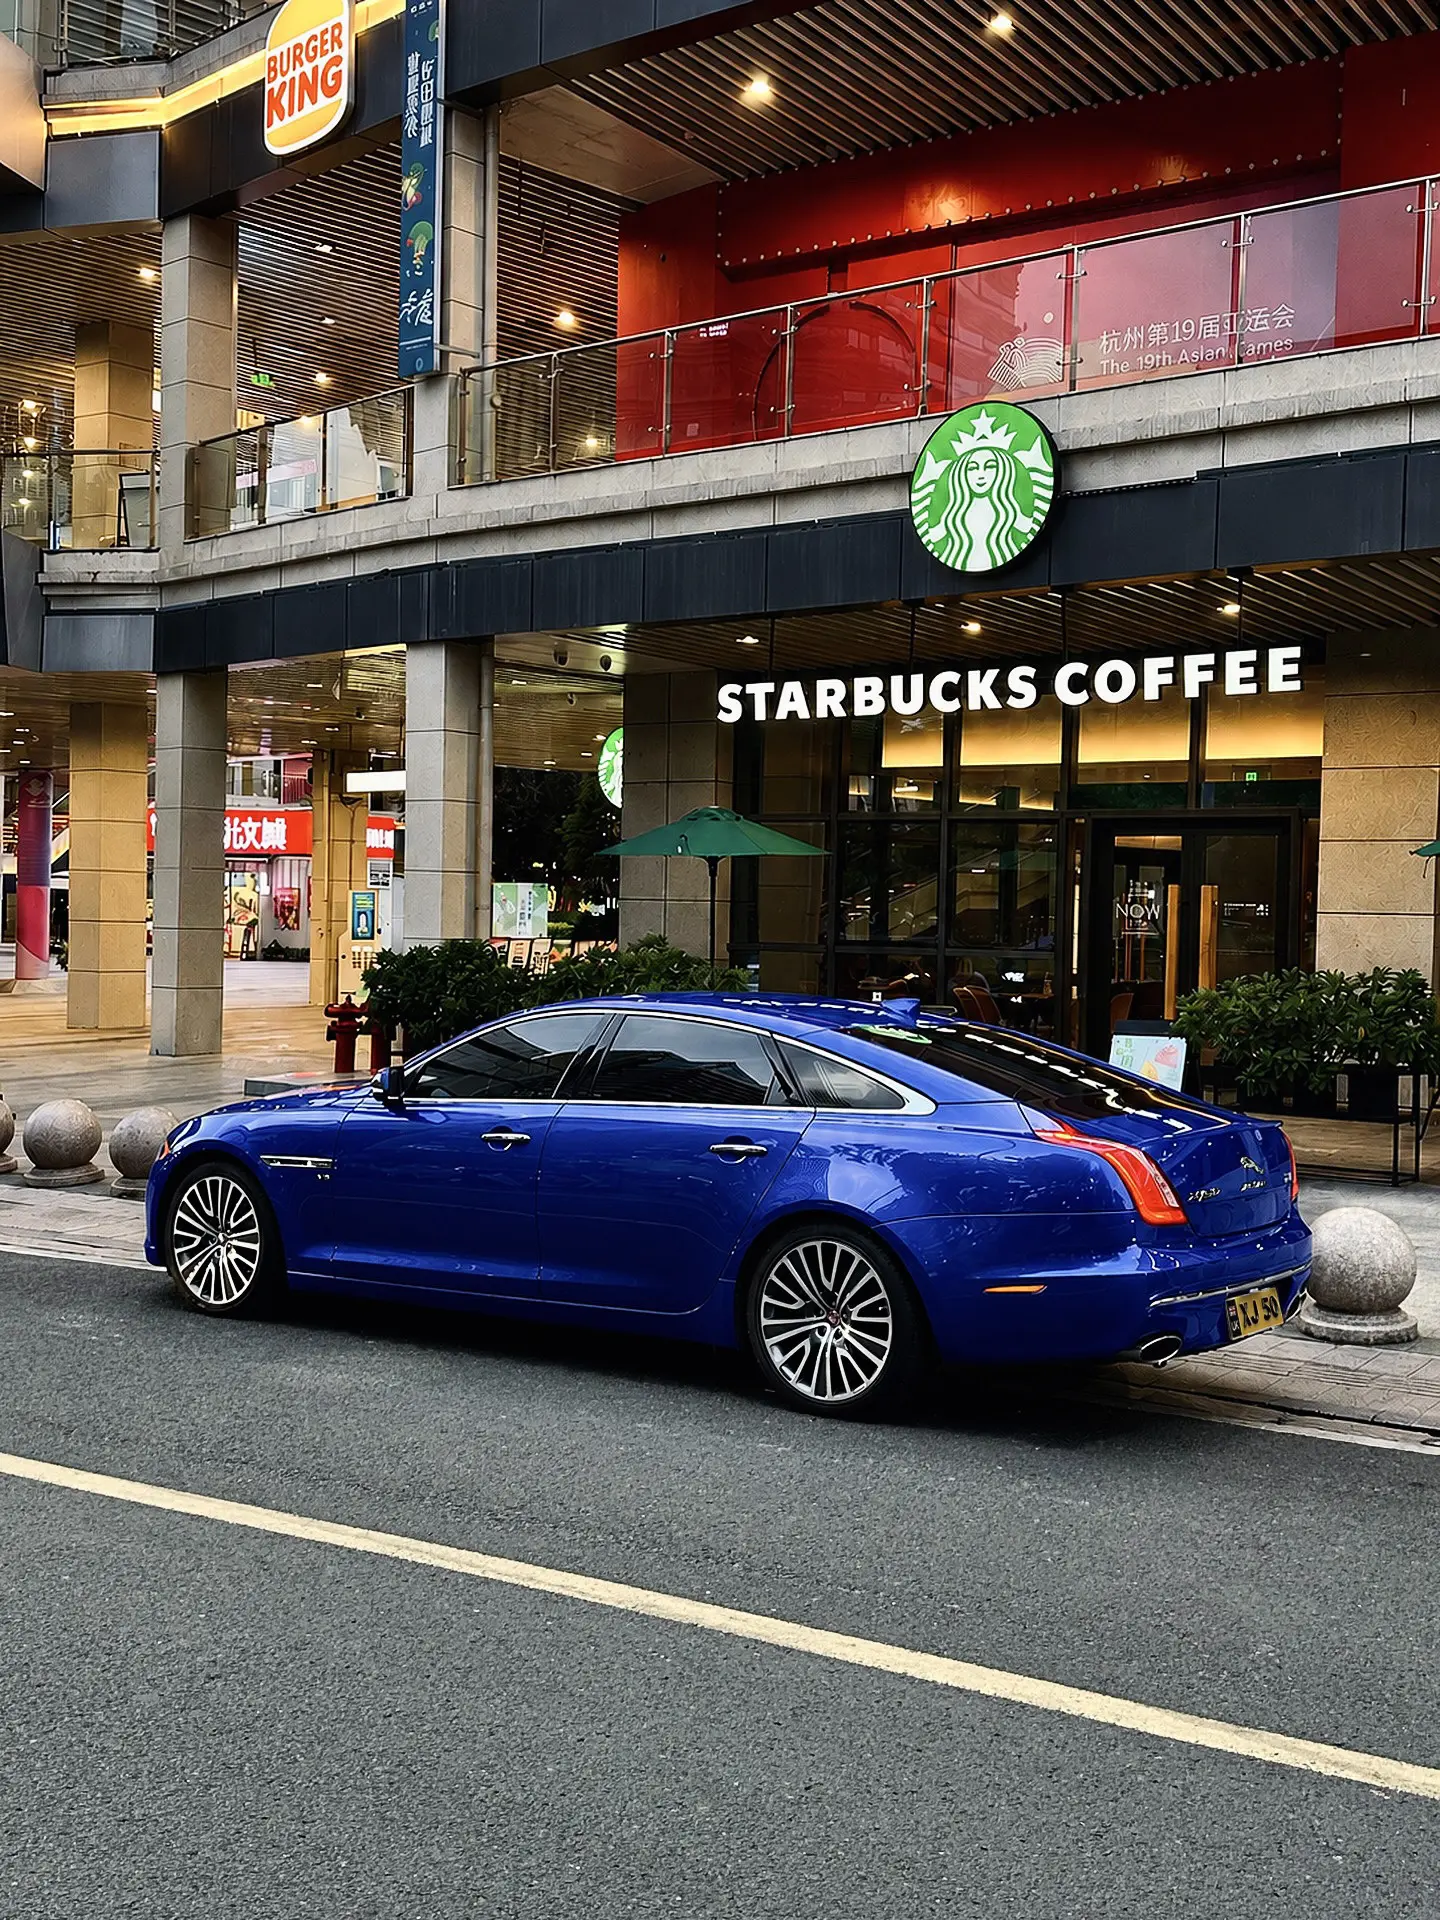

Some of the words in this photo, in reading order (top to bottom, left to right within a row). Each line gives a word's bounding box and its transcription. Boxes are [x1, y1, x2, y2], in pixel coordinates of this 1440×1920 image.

[267, 22, 343, 84] BURGER
[267, 55, 343, 129] KING
[1100, 359, 1130, 376] The
[1137, 350, 1172, 371] 19th
[716, 665, 1037, 723] STARBUCKS
[1054, 646, 1301, 706] COFFEE
[1115, 903, 1160, 921] NOW
[1239, 1300, 1260, 1328] XJ
[1261, 1295, 1279, 1321] 50
